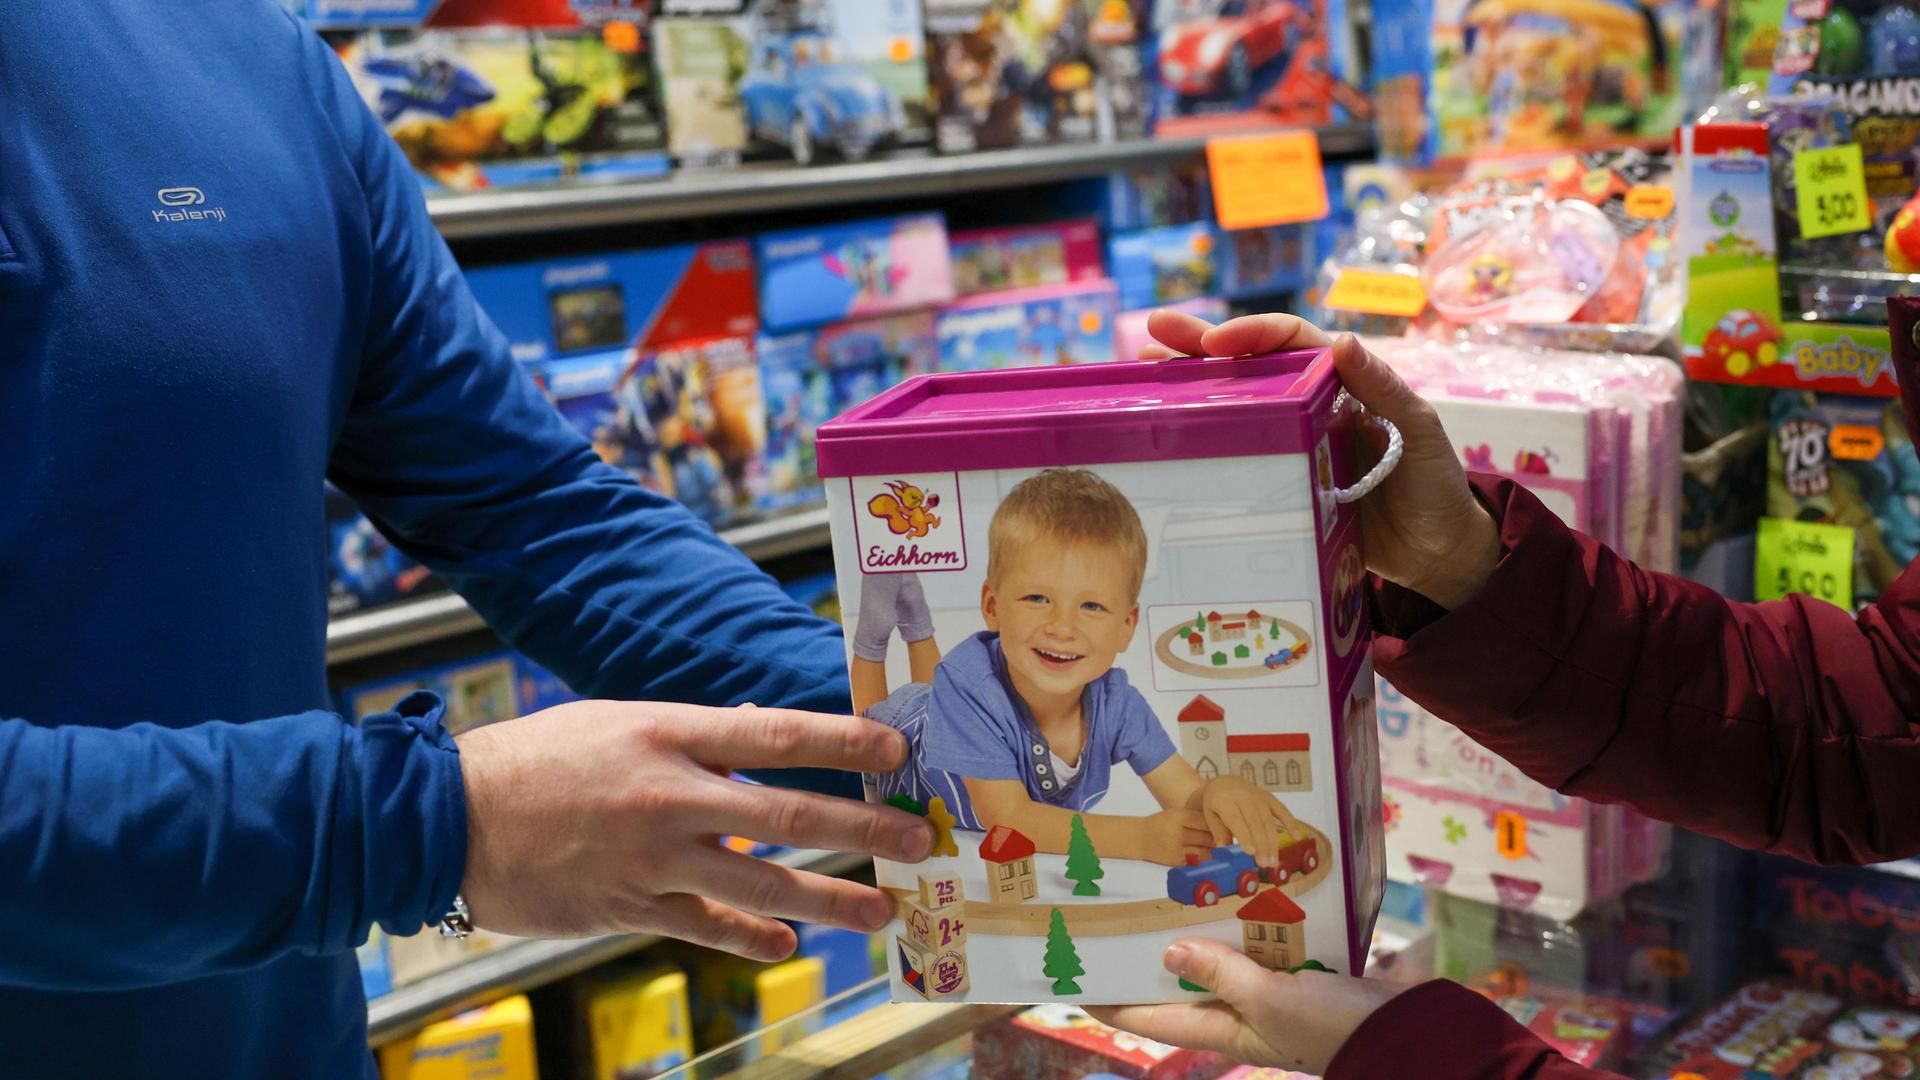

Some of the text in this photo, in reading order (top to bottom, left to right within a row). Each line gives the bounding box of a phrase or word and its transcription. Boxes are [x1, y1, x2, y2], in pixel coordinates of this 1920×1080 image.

[151, 207, 227, 222] Kalenji
[1795, 339, 1884, 384] Baby
[866, 544, 959, 567] Eichhorn
[935, 880, 955, 897] 25
[938, 896, 957, 907] pcs.
[938, 918, 964, 946] 2+
